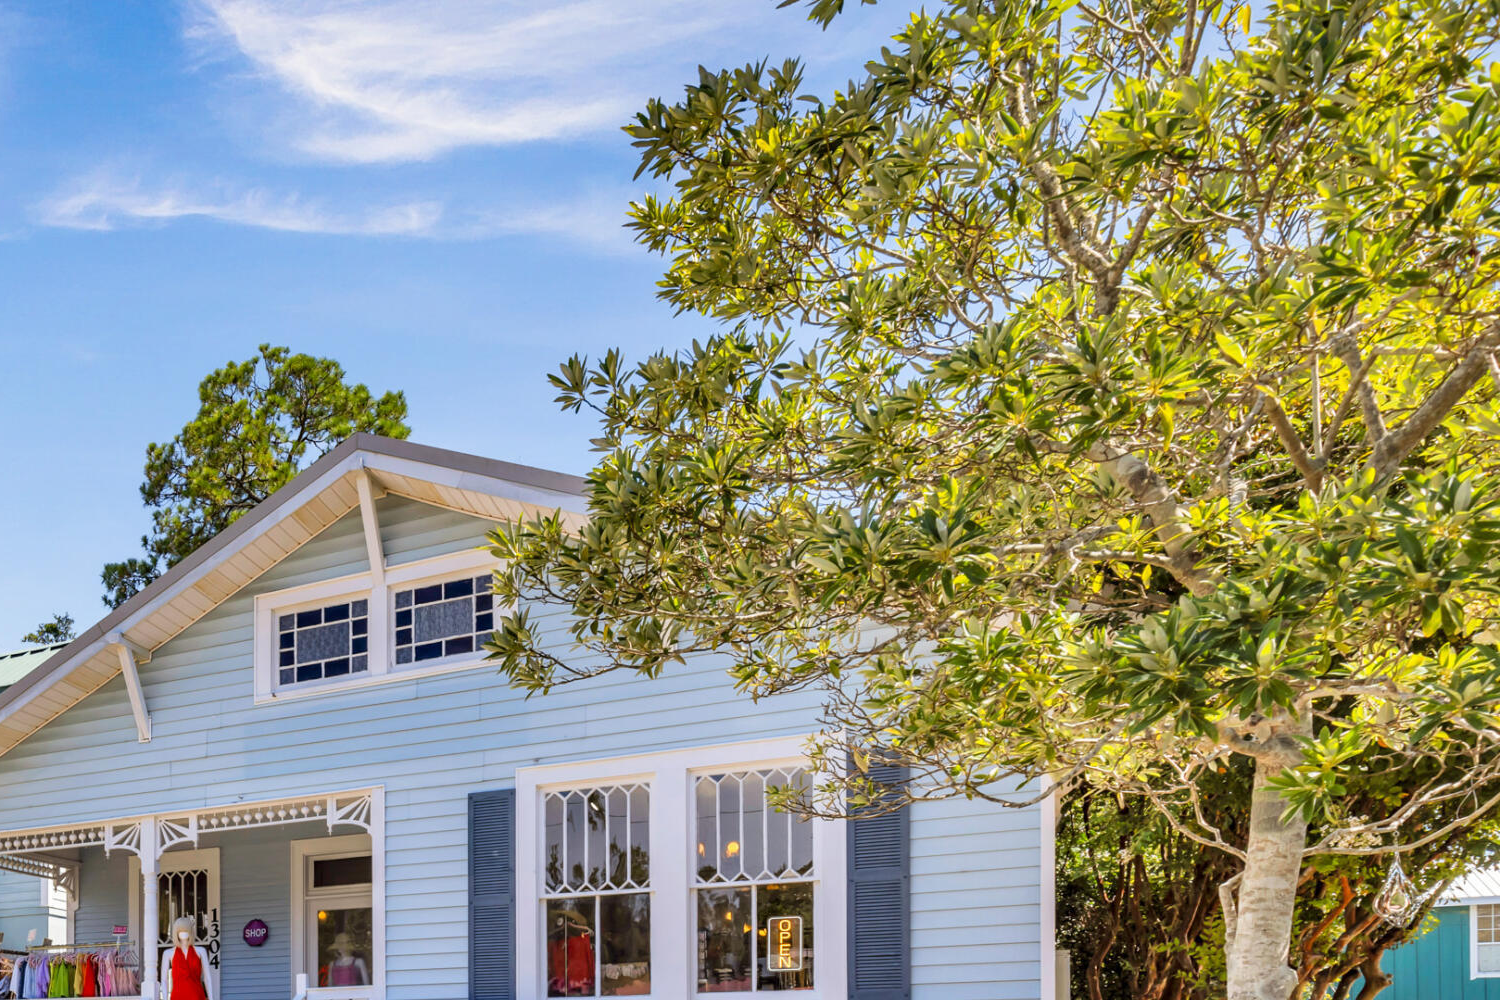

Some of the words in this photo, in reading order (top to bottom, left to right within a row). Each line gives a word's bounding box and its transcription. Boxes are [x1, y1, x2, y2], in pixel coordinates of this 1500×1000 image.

[209, 908, 220, 970] 1304
[245, 928, 266, 938] SHOP
[779, 919, 791, 968] OPEN
